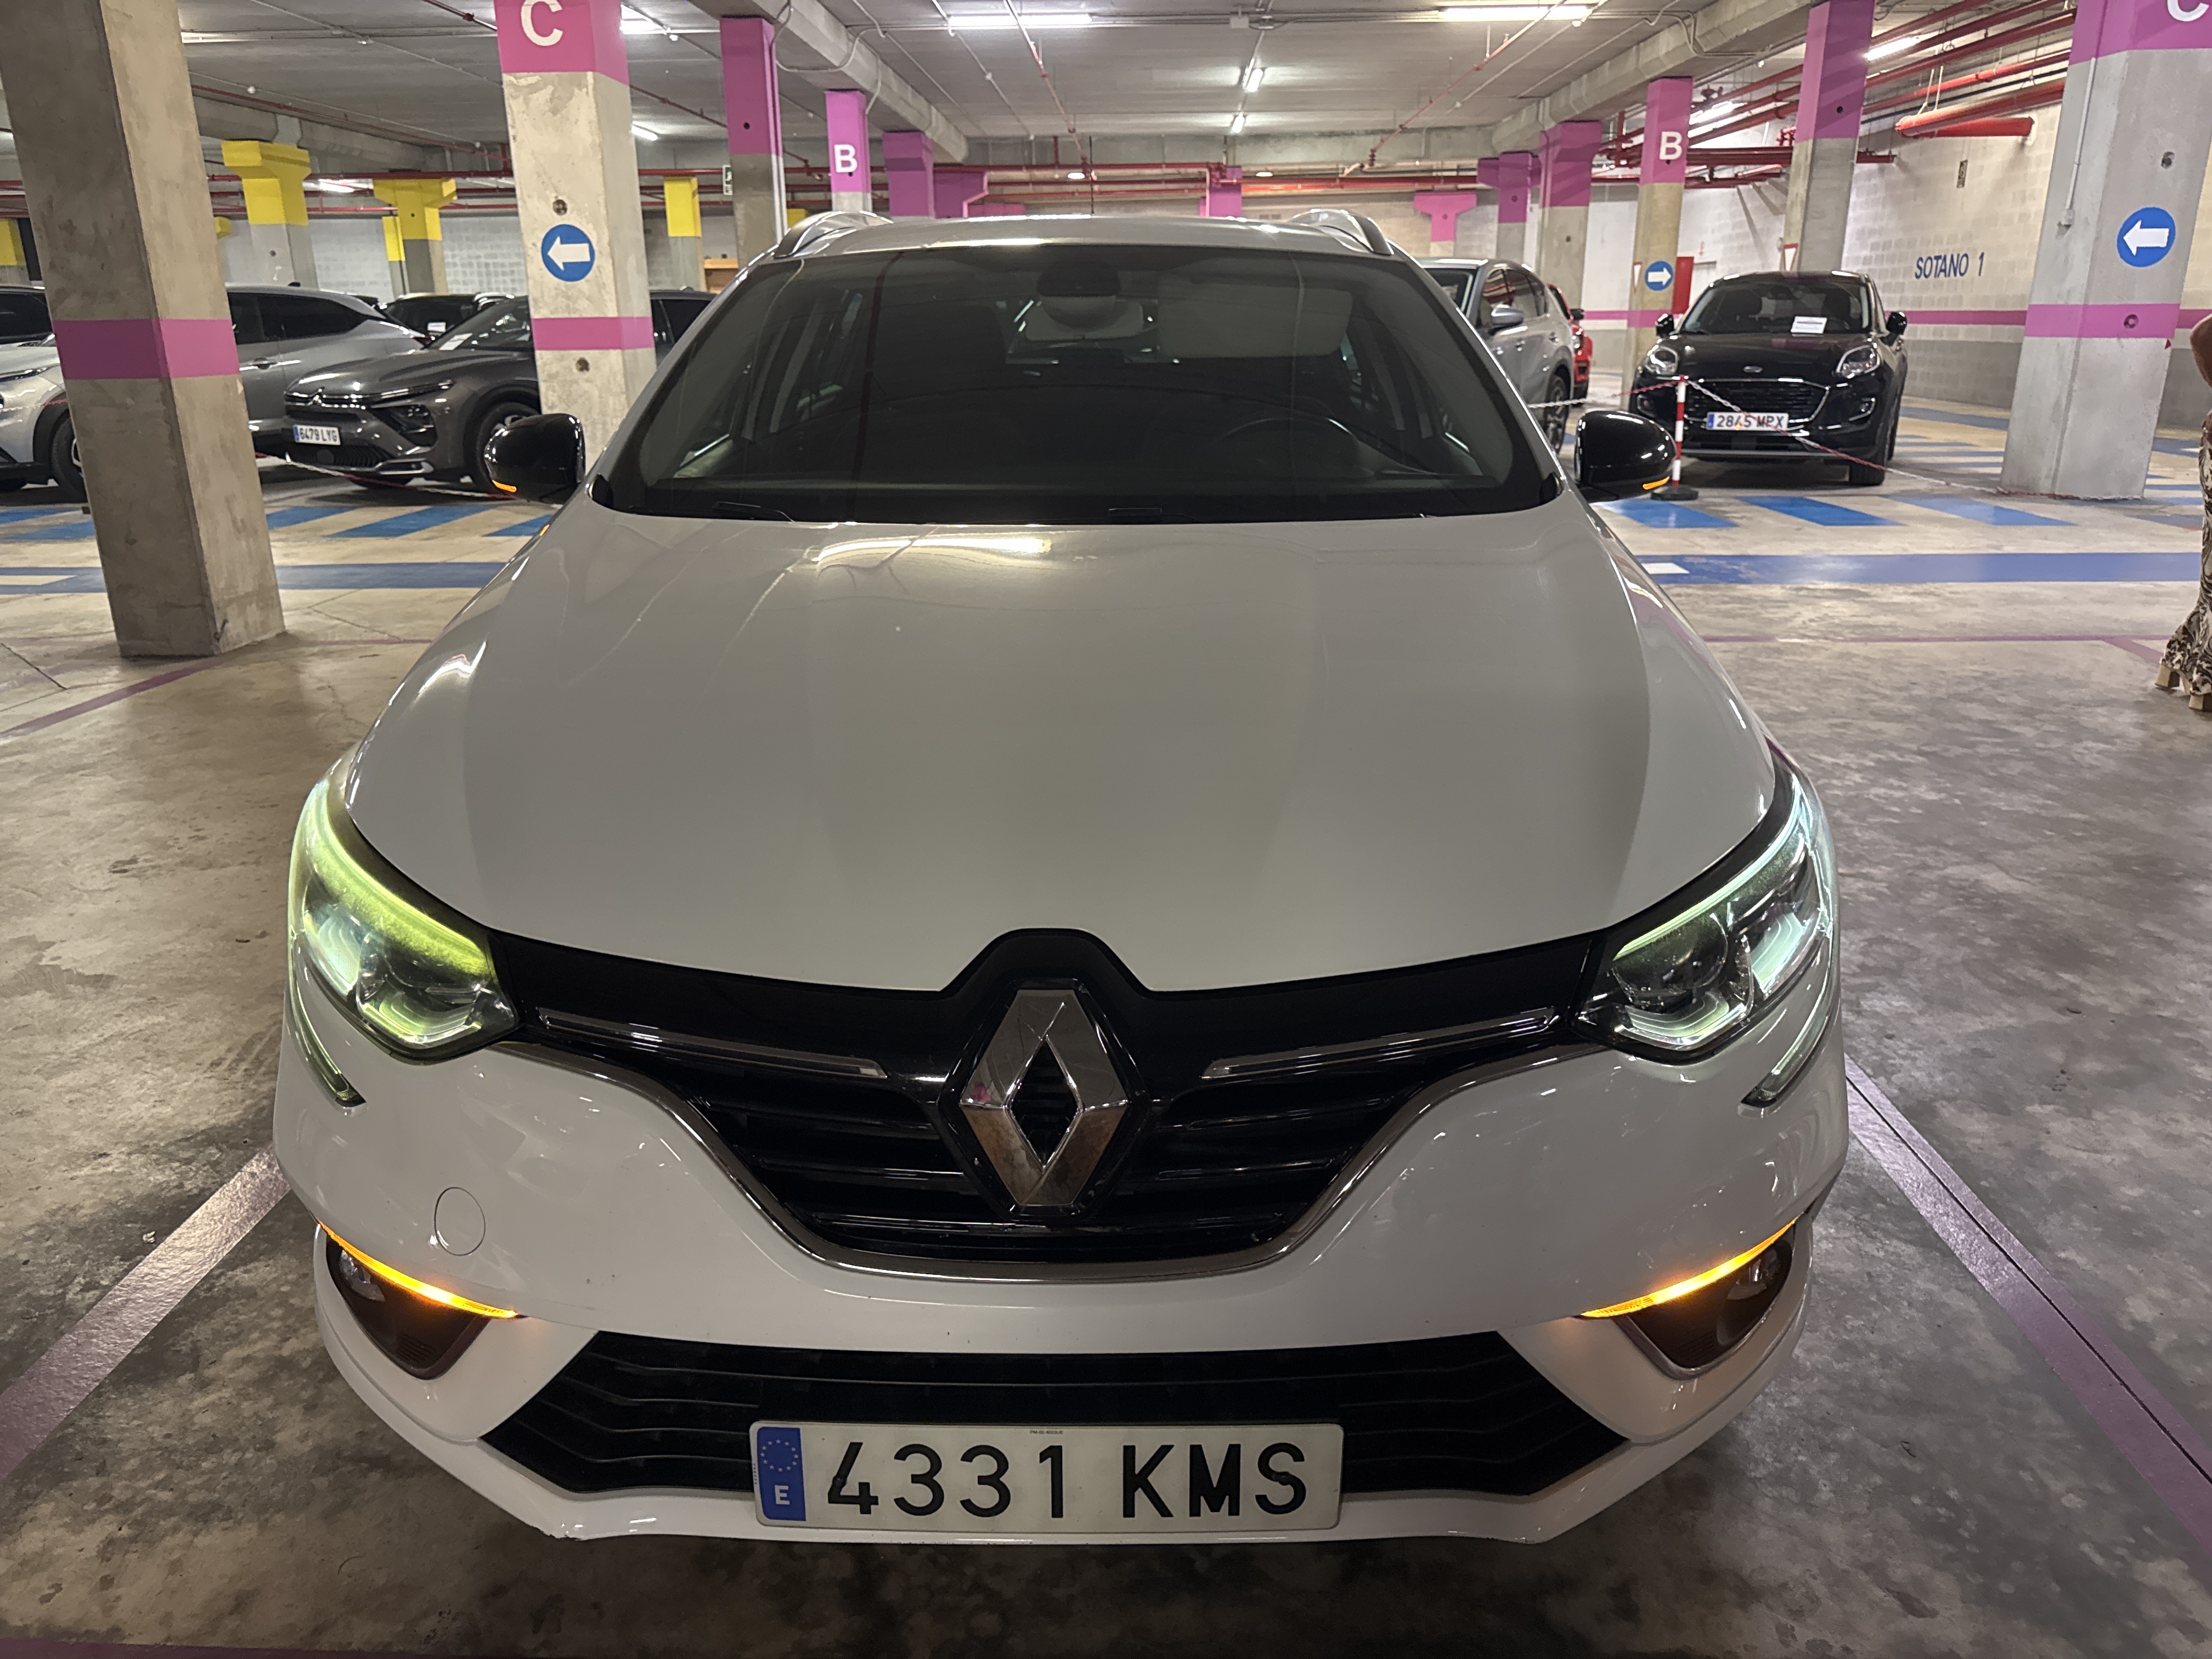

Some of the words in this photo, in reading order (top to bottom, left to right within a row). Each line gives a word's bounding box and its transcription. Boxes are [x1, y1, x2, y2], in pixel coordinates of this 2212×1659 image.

[521, 0, 563, 46] C
[834, 144, 858, 173] B
[1659, 131, 1683, 160] B
[1915, 252, 1969, 279] SOTANO
[1979, 252, 1984, 276] 1
[299, 427, 320, 441] 6479
[827, 1441, 1064, 1518] 4331
[1122, 1442, 1306, 1518] KMS
[774, 1485, 790, 1505] E
